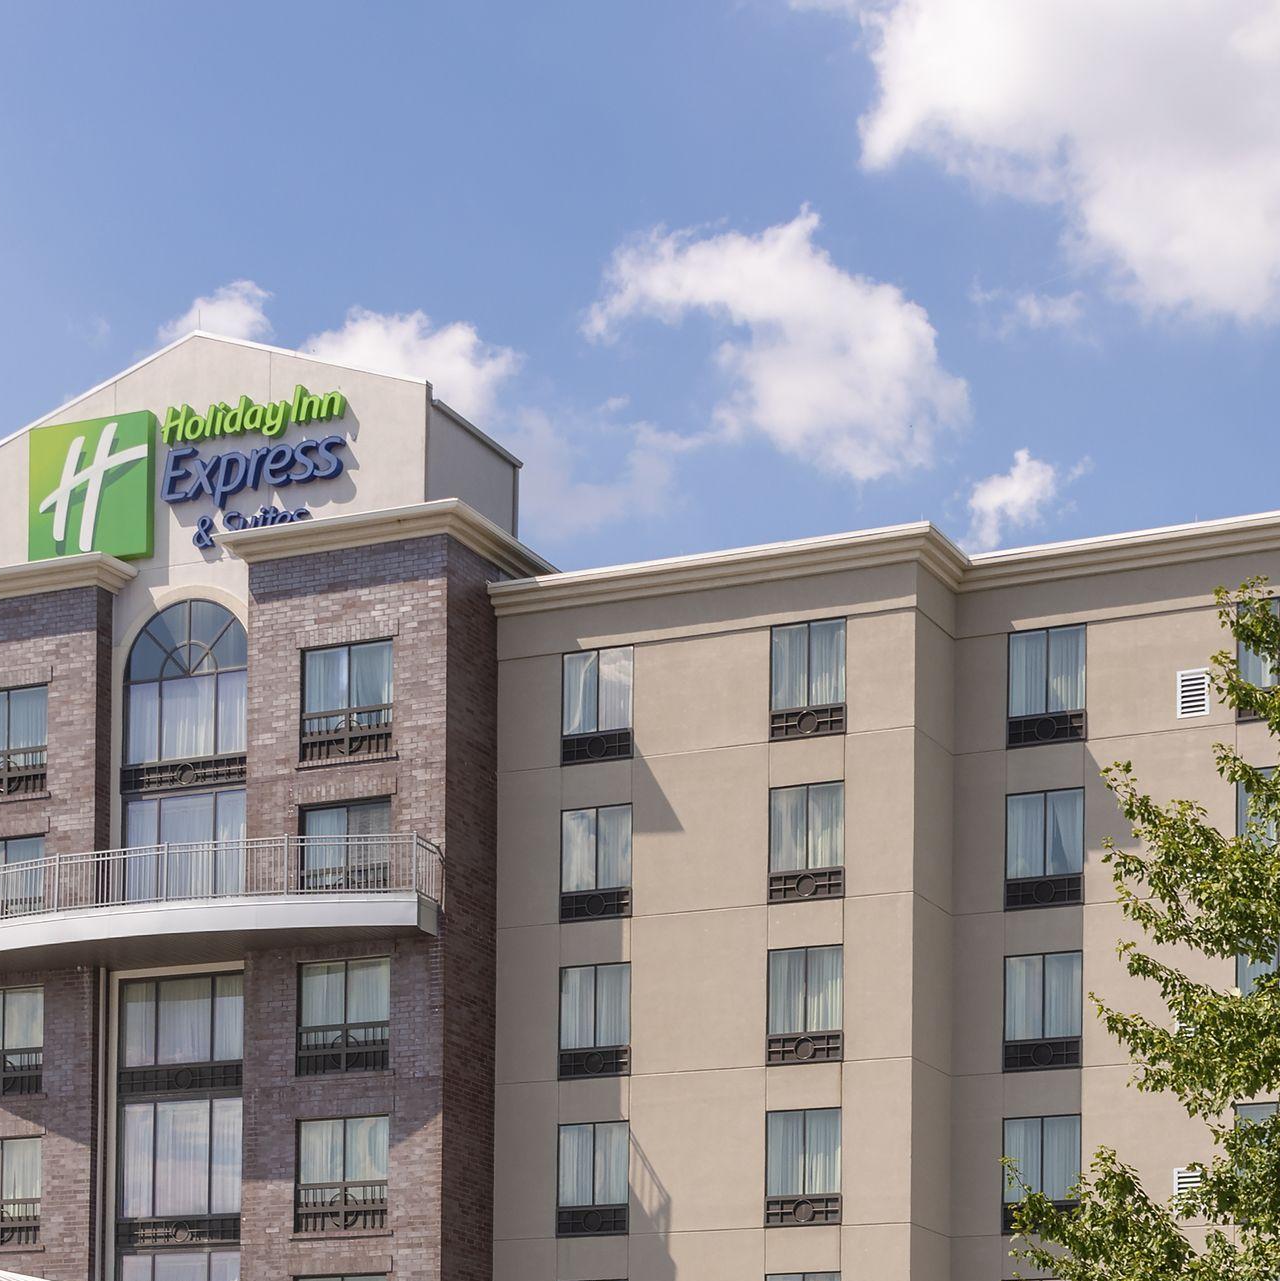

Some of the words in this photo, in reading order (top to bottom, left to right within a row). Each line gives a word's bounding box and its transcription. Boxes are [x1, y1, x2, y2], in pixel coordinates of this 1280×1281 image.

[161, 394, 291, 445] Holiday
[291, 384, 347, 425] Inn
[160, 435, 346, 510] Express
[192, 515, 215, 548] &
